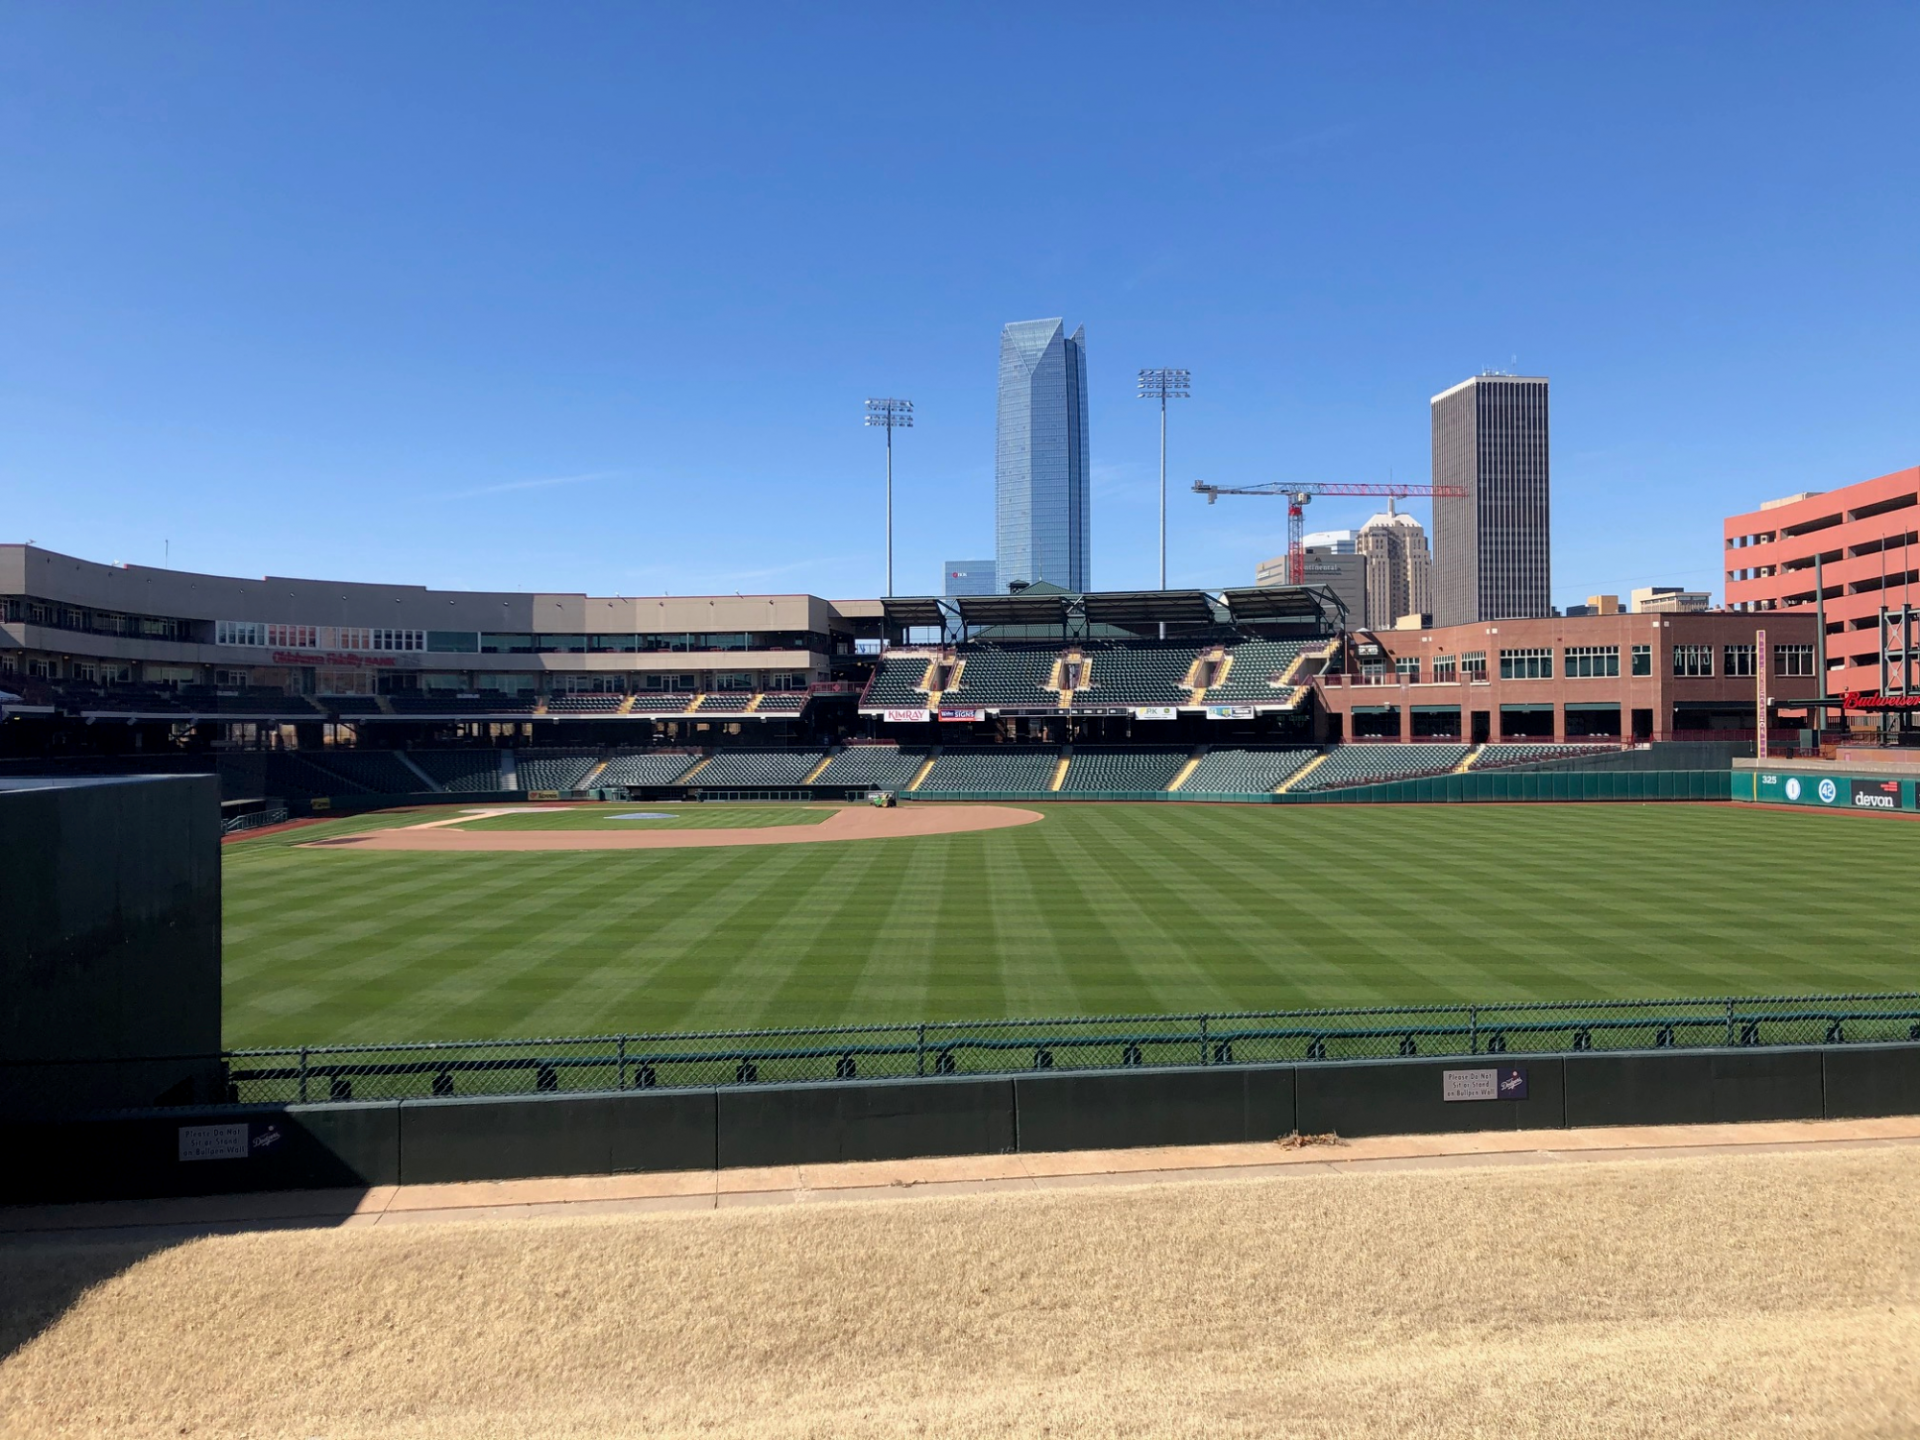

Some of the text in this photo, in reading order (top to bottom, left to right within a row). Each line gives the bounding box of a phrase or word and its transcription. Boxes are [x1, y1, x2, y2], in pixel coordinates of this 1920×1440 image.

[1839, 691, 1920, 709] Budweiser
[888, 710, 924, 720] KIMRAY
[954, 710, 974, 718] SIGNS
[1762, 776, 1777, 784] 325
[1821, 786, 1834, 796] 42
[1855, 791, 1894, 807] devon
[1456, 1089, 1479, 1097] Bullpen
[185, 1130, 210, 1138] Please
[213, 1128, 224, 1136] Do
[191, 1139, 201, 1147] Sit
[215, 1137, 238, 1145] Stand
[195, 1147, 224, 1156] Bullpen
